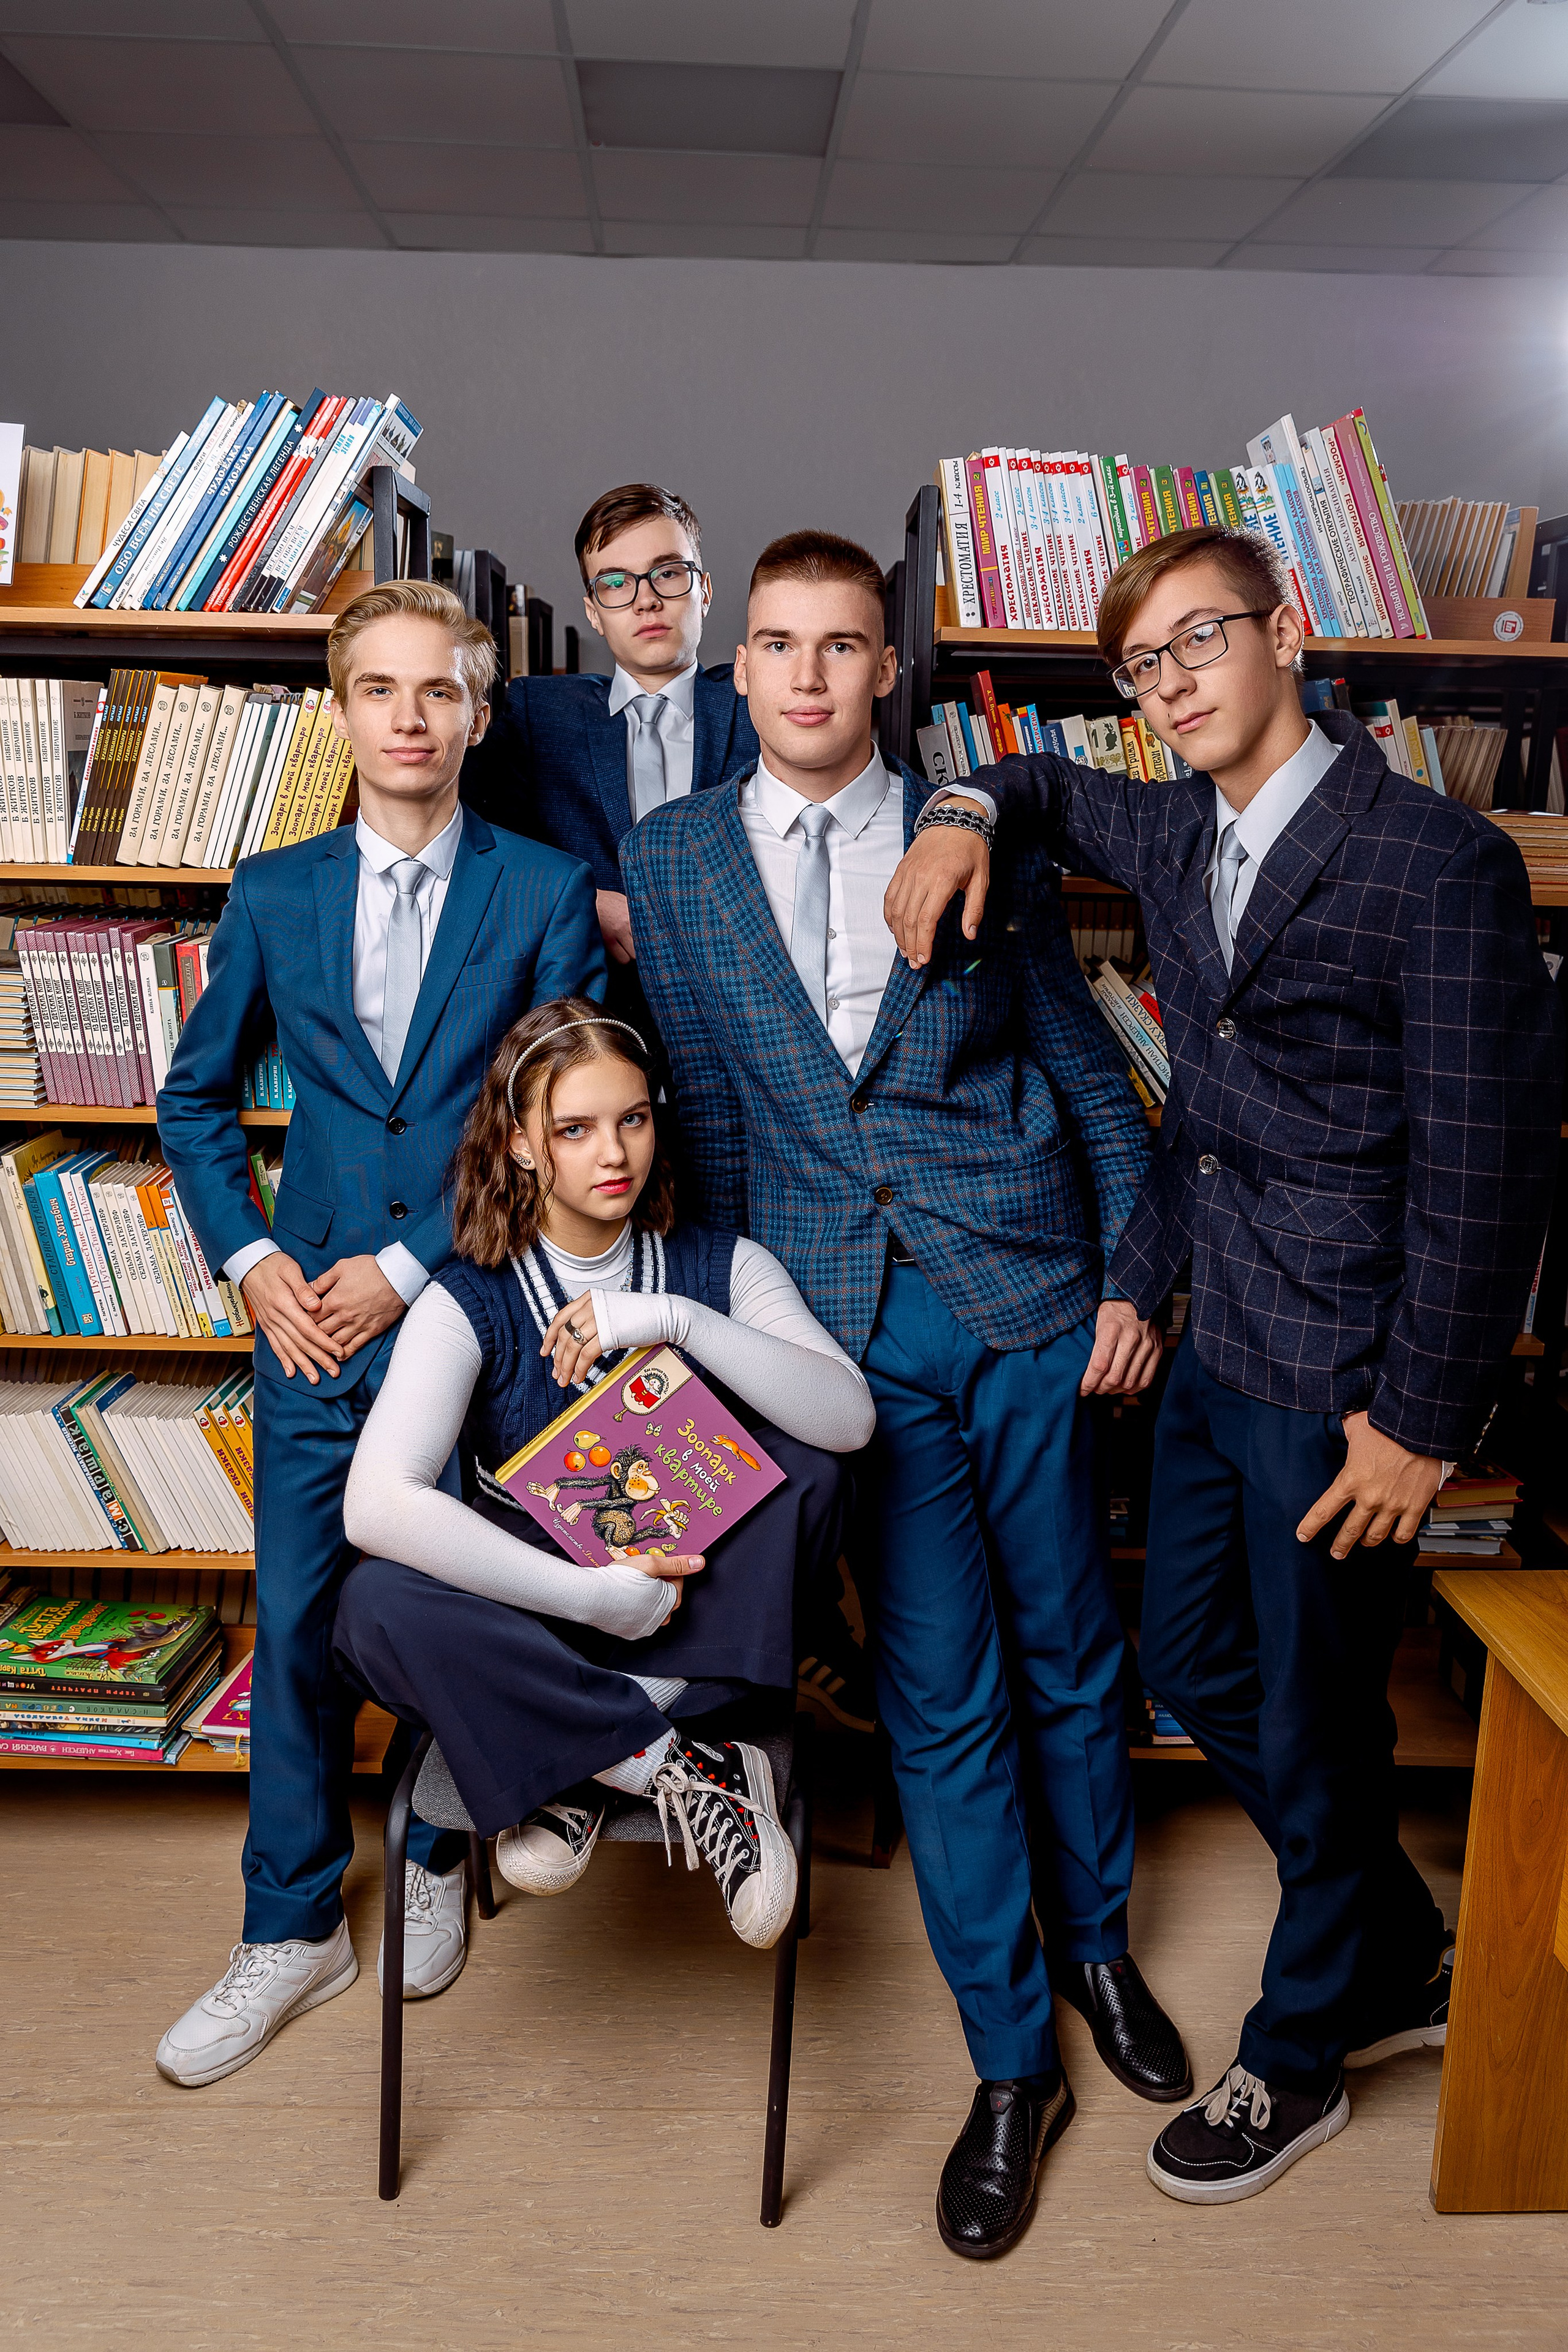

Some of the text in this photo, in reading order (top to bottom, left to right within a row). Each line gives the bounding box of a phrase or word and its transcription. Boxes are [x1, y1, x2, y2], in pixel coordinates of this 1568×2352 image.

[332, 434, 346, 454] ЗЕМЛЯ
[341, 434, 355, 454] ЗЕМЛЯ
[227, 440, 295, 548] РОЖДЕСТВЕНСКАЯ ЛЕГЕНДА
[953, 460, 963, 508] 1-4 классы
[1087, 489, 1096, 511] класс
[1286, 489, 1298, 518] КЛАССОВ
[1294, 489, 1305, 519] КЛАССОВ
[1300, 467, 1323, 533] ПЕРВООТКРЫВАТЕЛИ
[113, 499, 147, 547] ЧУДЕСА СВЕТА
[115, 550, 133, 575] ОБО
[129, 519, 152, 550] ВСЁМ
[148, 502, 164, 522] НА
[160, 464, 185, 500] СВЕТЕ
[973, 484, 991, 555] МИР ЧТЕНИЯ
[996, 511, 1003, 519] 2
[1140, 491, 1156, 536] ЧТЕНИЯ
[1320, 499, 1336, 537] ОТКРЫТИЯ
[1324, 468, 1357, 563] АЗБУКА ВЫЖИВАНИЯ
[266, 525, 295, 571] ВСЕ ОБО ВСЕМ
[1021, 530, 1030, 564] ЧТЕНИЕ
[1046, 533, 1055, 566] ЧТЕНИЕ
[1095, 534, 1106, 567] ЧТЕНИЕ
[1294, 519, 1311, 559] НАЧАЛЬНЫХ
[1302, 521, 1317, 560] НАЧАЛЬНЫХ
[1344, 493, 1365, 548] ГЕОГРАФИЯ
[1362, 555, 1386, 620] ЭНЦИКЛОПЕДИЯ
[954, 522, 975, 605] ХРЕСТОМАТИЯ
[1307, 561, 1316, 574] ДЛЯ
[1314, 562, 1323, 575] ДЛЯ
[1332, 538, 1356, 604] ГЕОГРАФИЧЕСКИЕ
[1368, 512, 1406, 621] НОВЫЙ ГОД И РОЖДЕСТВО
[1311, 577, 1328, 619] ХРЕСТОМАТИЯ
[1319, 578, 1336, 620] ХРЕСТОМАТИЯ
[2, 719, 11, 761] ИЗБРАННОЕ
[12, 720, 22, 761] ИЗБРАННОЕ
[24, 722, 33, 763] ИЗБРАННОЕ
[1126, 740, 1139, 770] Гримм
[7, 774, 18, 813] ЖИТКОВ
[18, 775, 28, 813] ЖИТКОВ
[29, 777, 39, 815] ЖИТКОВ
[43, 775, 53, 815] ЖИТКОВ
[129, 722, 162, 838] ЗА ГОРАМИ, ЗА ЛЕСАМИ...
[149, 723, 183, 840] ЗА ГОРАМИ, ЗА ЛЕСАМИ...
[172, 723, 205, 839] ЗА ГОРАМИ, ЗА ЛЕСАМИ...
[194, 726, 228, 843] ЗА ГОРАМИ, ЗА ЛЕСАМИ...
[271, 802, 287, 835] Зоопарк
[289, 726, 309, 768] квартире
[289, 802, 305, 837] Зоопарк
[307, 727, 326, 769] квартире
[24, 978, 40, 1029] ИЗ ДЕТСКИХ КНИГ
[35, 978, 51, 1029] ИЗ ДЕТСКИХ КНИГ
[44, 978, 53, 992] КНИГ
[53, 979, 62, 994] КНИГ
[64, 979, 72, 993] КНИГ
[48, 993, 59, 1020] ДЕТСКИХ
[58, 996, 69, 1022] ДЕТСКИХ
[67, 995, 77, 1020] ДЕТСКИХ
[1125, 993, 1152, 1026] СКАЗКИ
[27, 1191, 58, 1275] СТАРИК ХОТТАБЫЧ
[49, 1197, 77, 1267] Старик Хоттабыч
[110, 1250, 123, 1279] СЕЛЬМА
[124, 1251, 137, 1280] СЕЛЬМА
[135, 1250, 147, 1280] СЕЛЬМА
[180, 1238, 198, 1291] ЧУДЕСНОЕ ПУТЕШЕСТВИЕ
[183, 1262, 191, 1281] ДИКИМИ
[197, 1252, 213, 1290] ХОТТАБЫЧ
[676, 1417, 736, 1485] Зоопарк
[681, 1448, 720, 1493] в моей
[654, 1443, 723, 1517] квартире
[18, 1607, 60, 1634] Тутта
[27, 1600, 81, 1640] Карлссон
[22, 1703, 64, 1712] СЕВЕРА
